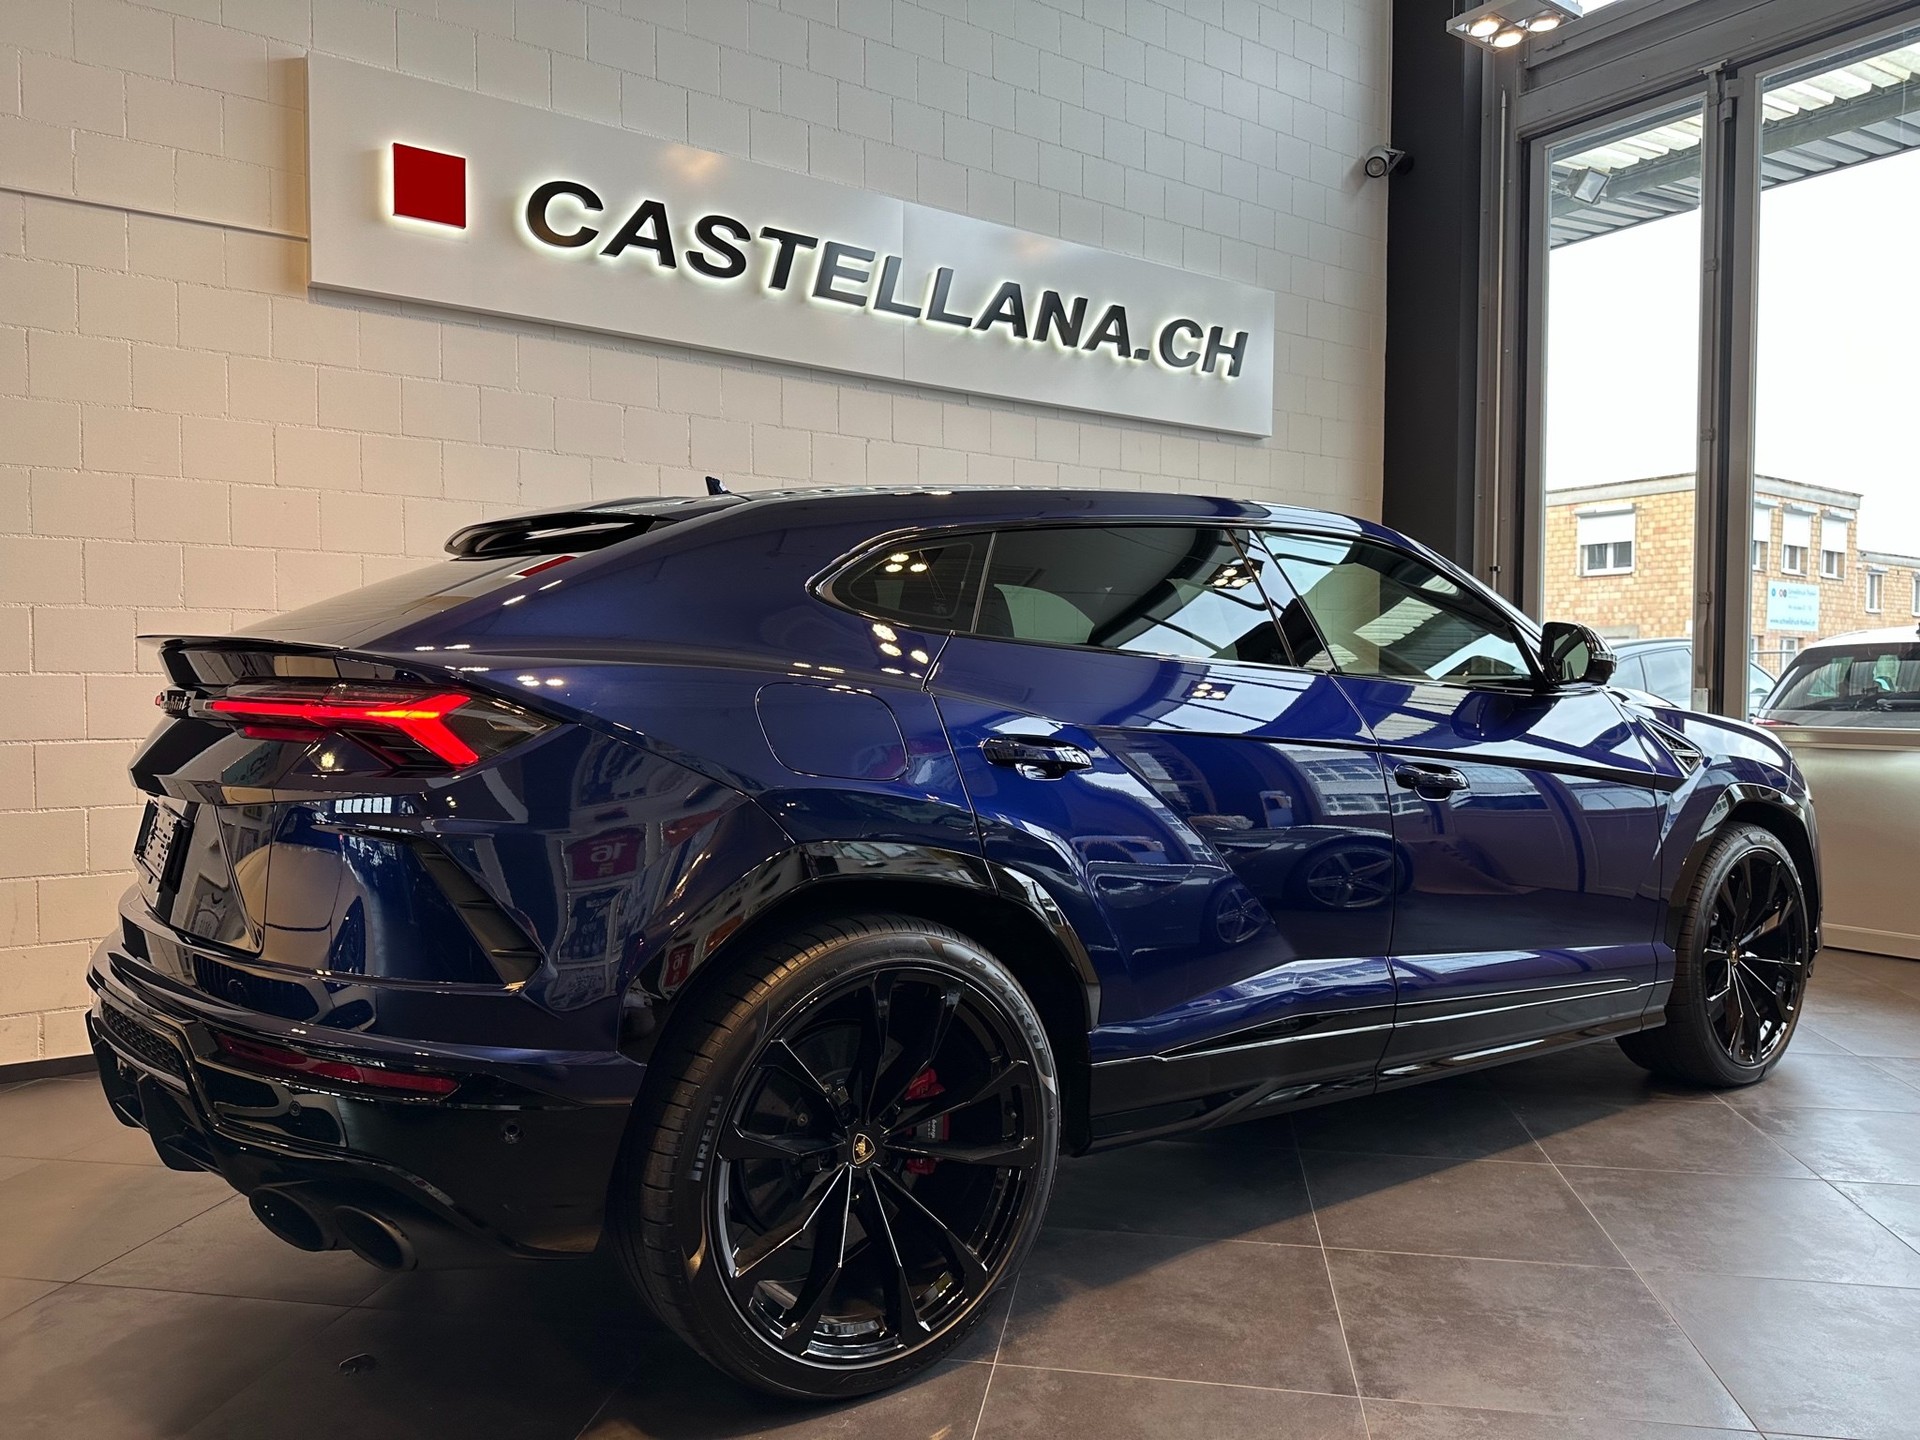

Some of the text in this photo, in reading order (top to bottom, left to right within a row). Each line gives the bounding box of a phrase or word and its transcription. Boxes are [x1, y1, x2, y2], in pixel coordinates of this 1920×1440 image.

[525, 180, 1249, 377] CASTELLANA.CH
[966, 957, 1045, 1050] P ZERO
